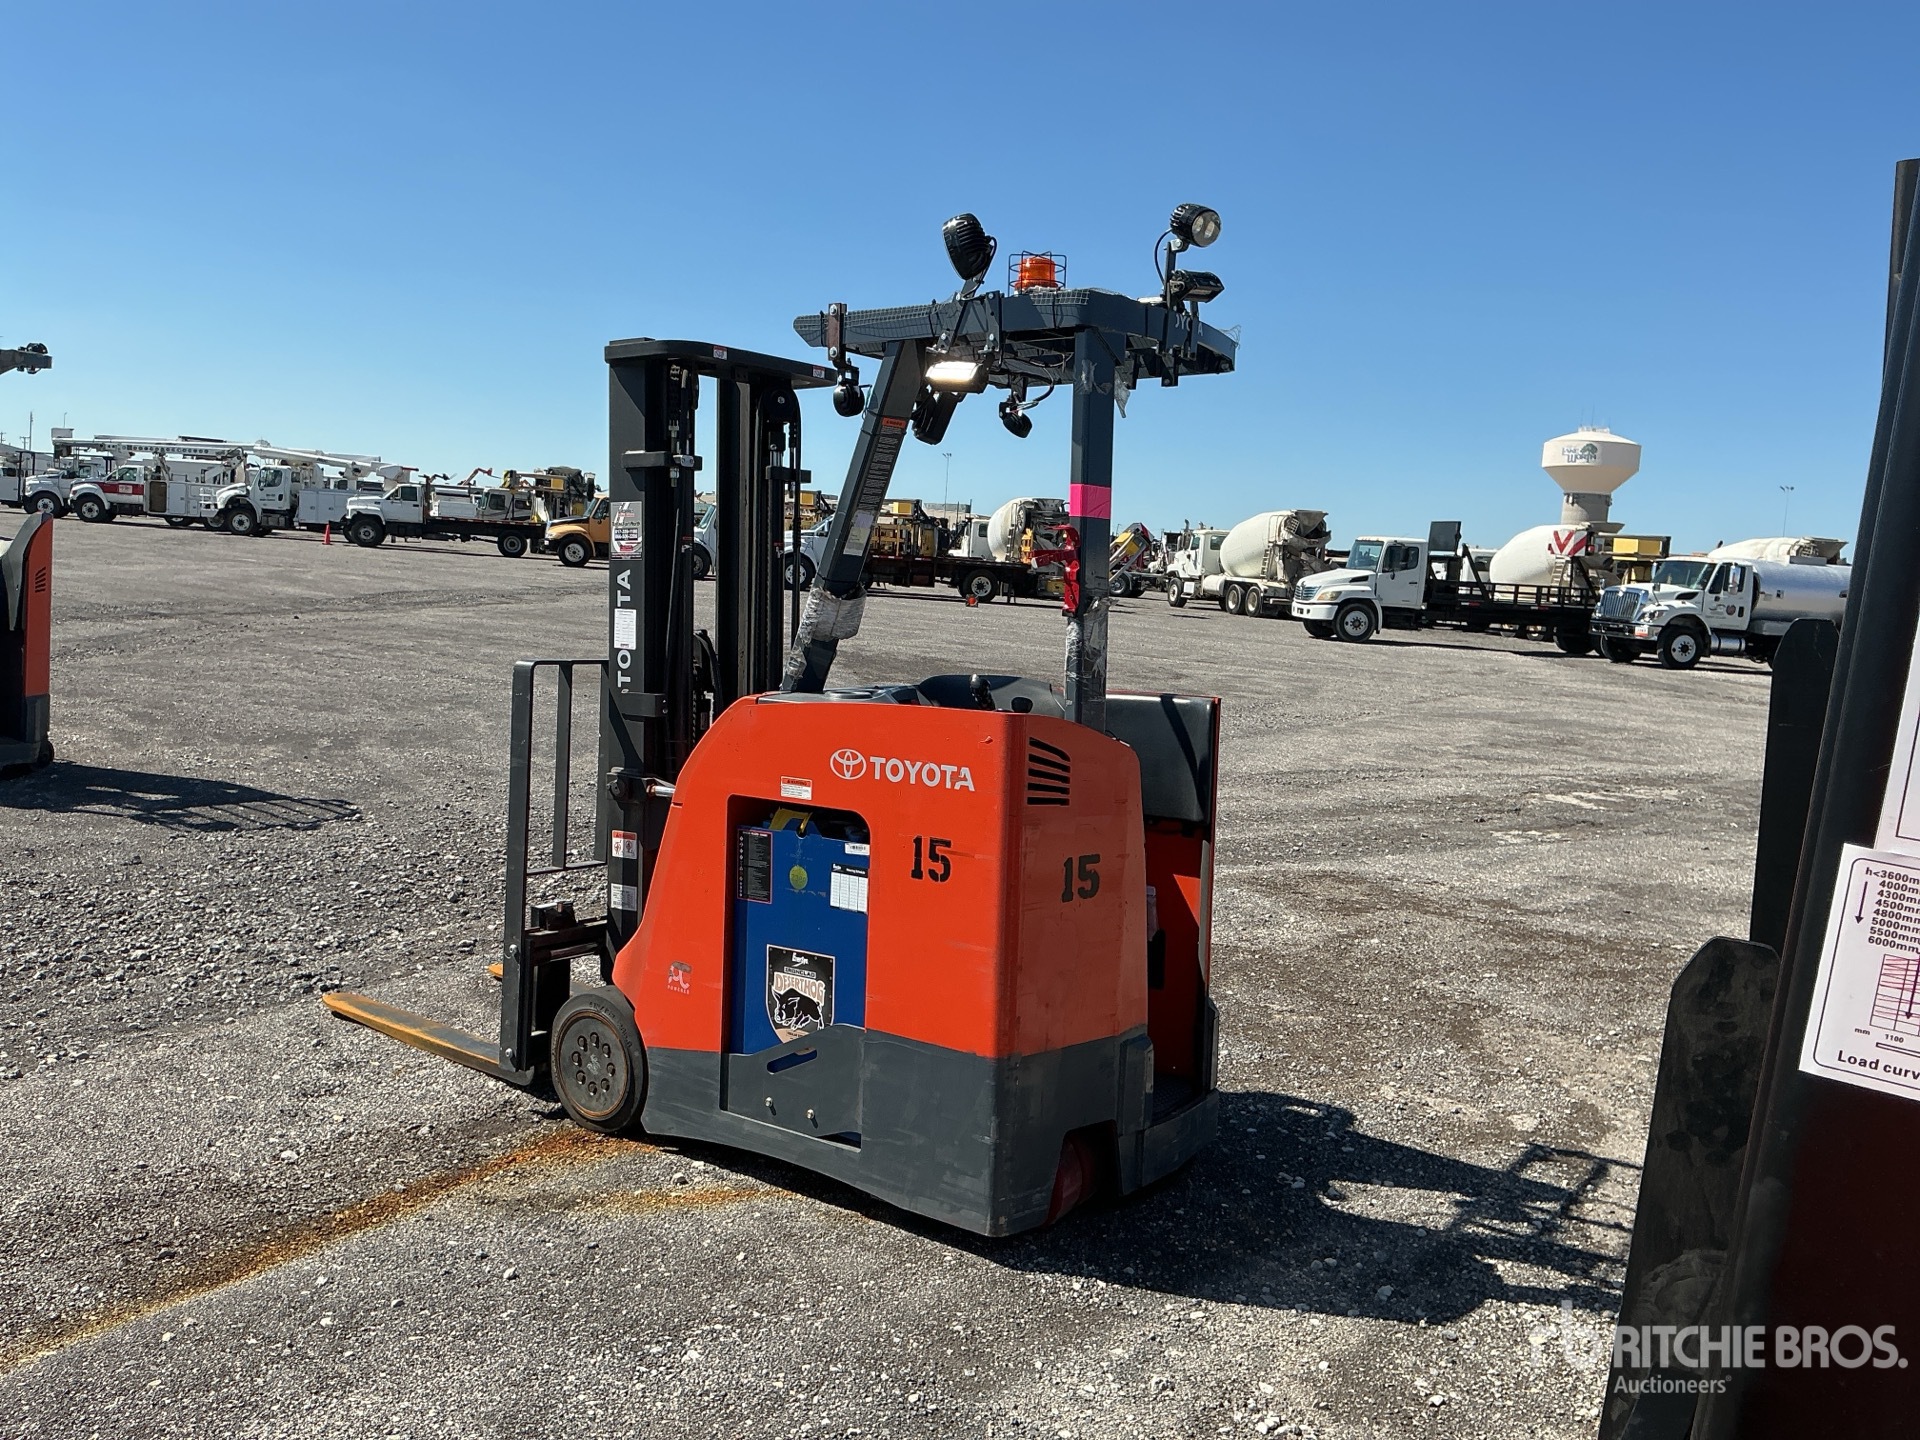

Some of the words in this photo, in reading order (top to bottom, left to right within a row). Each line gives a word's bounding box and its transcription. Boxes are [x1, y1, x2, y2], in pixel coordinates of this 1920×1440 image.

[616, 569, 631, 688] TOTA
[869, 756, 976, 792] TOYOTA
[911, 835, 952, 883] 15
[1061, 854, 1101, 903] 15
[1879, 880, 1920, 895] 4000m
[1877, 889, 1920, 905] 4300m
[1868, 936, 1918, 953] 6000mm
[1869, 926, 1920, 944] 5500mm
[1885, 1034, 1904, 1043] 1100
[1837, 1050, 1880, 1070] Load
